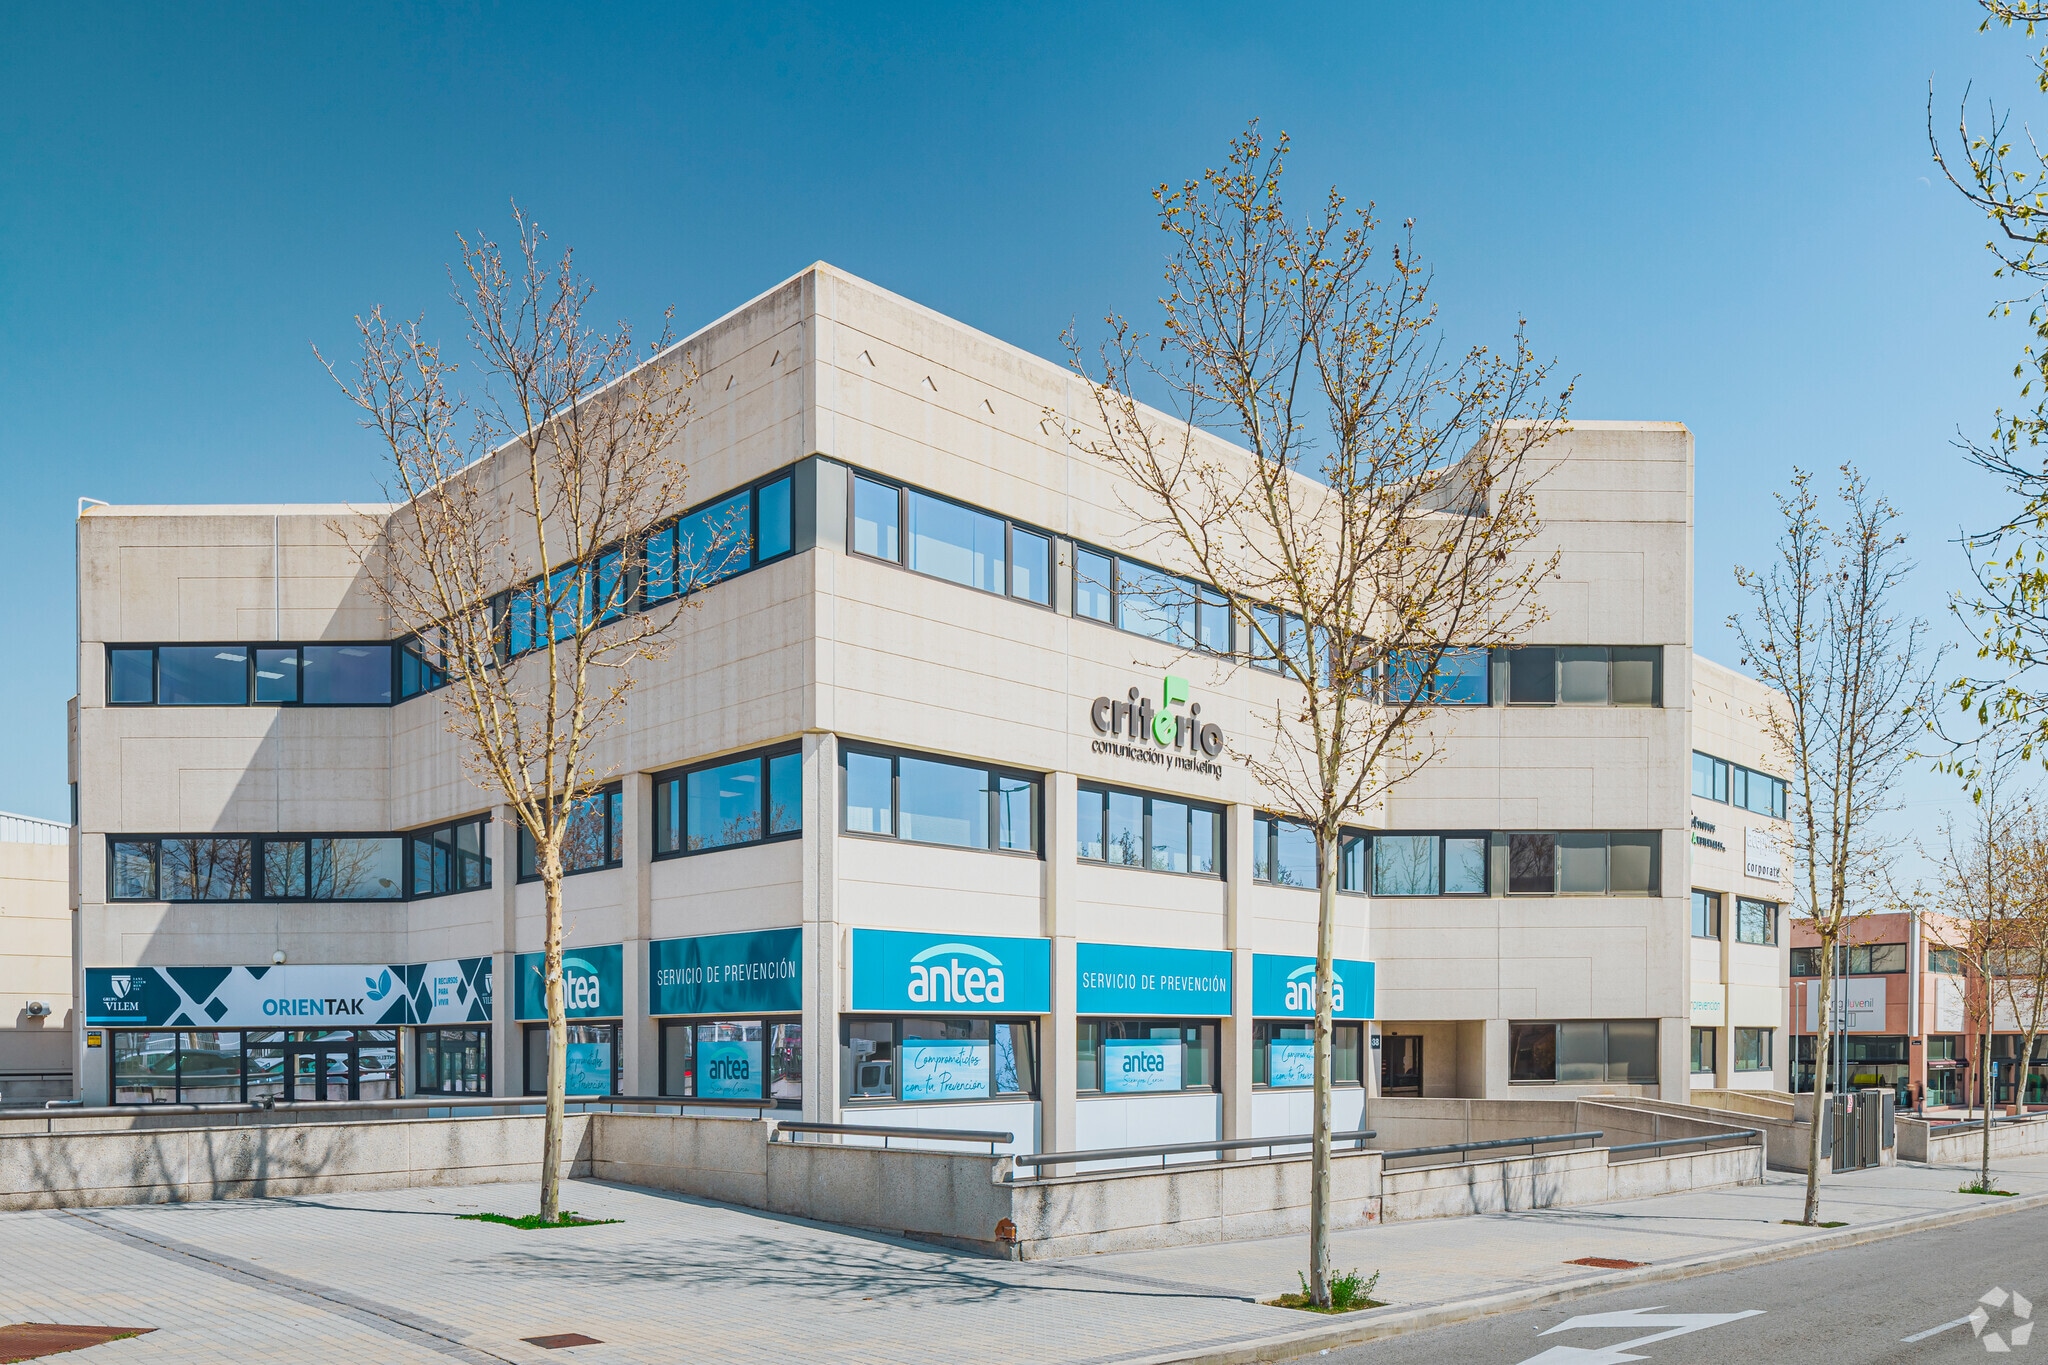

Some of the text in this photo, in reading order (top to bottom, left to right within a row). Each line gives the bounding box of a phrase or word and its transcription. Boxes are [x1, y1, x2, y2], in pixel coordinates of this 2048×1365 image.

[1092, 740, 1222, 779] comunicación y marketing
[1746, 862, 1780, 877] corporate
[657, 957, 796, 986] SERVICIO DE PREVENCIÓN
[908, 959, 1005, 1003] antea
[1082, 971, 1227, 994] SERVICIO DE PREVENCIÓN
[544, 970, 600, 1010] ntea
[1285, 977, 1344, 1012] anta
[104, 1002, 139, 1011] VILEM
[262, 998, 365, 1016] ORIENTAK
[1371, 1038, 1380, 1046] 38
[709, 1056, 749, 1080] antea
[914, 1045, 981, 1072] Comprometidos
[1122, 1051, 1164, 1073] antea
[905, 1084, 923, 1092] con
[925, 1074, 935, 1094] tu
